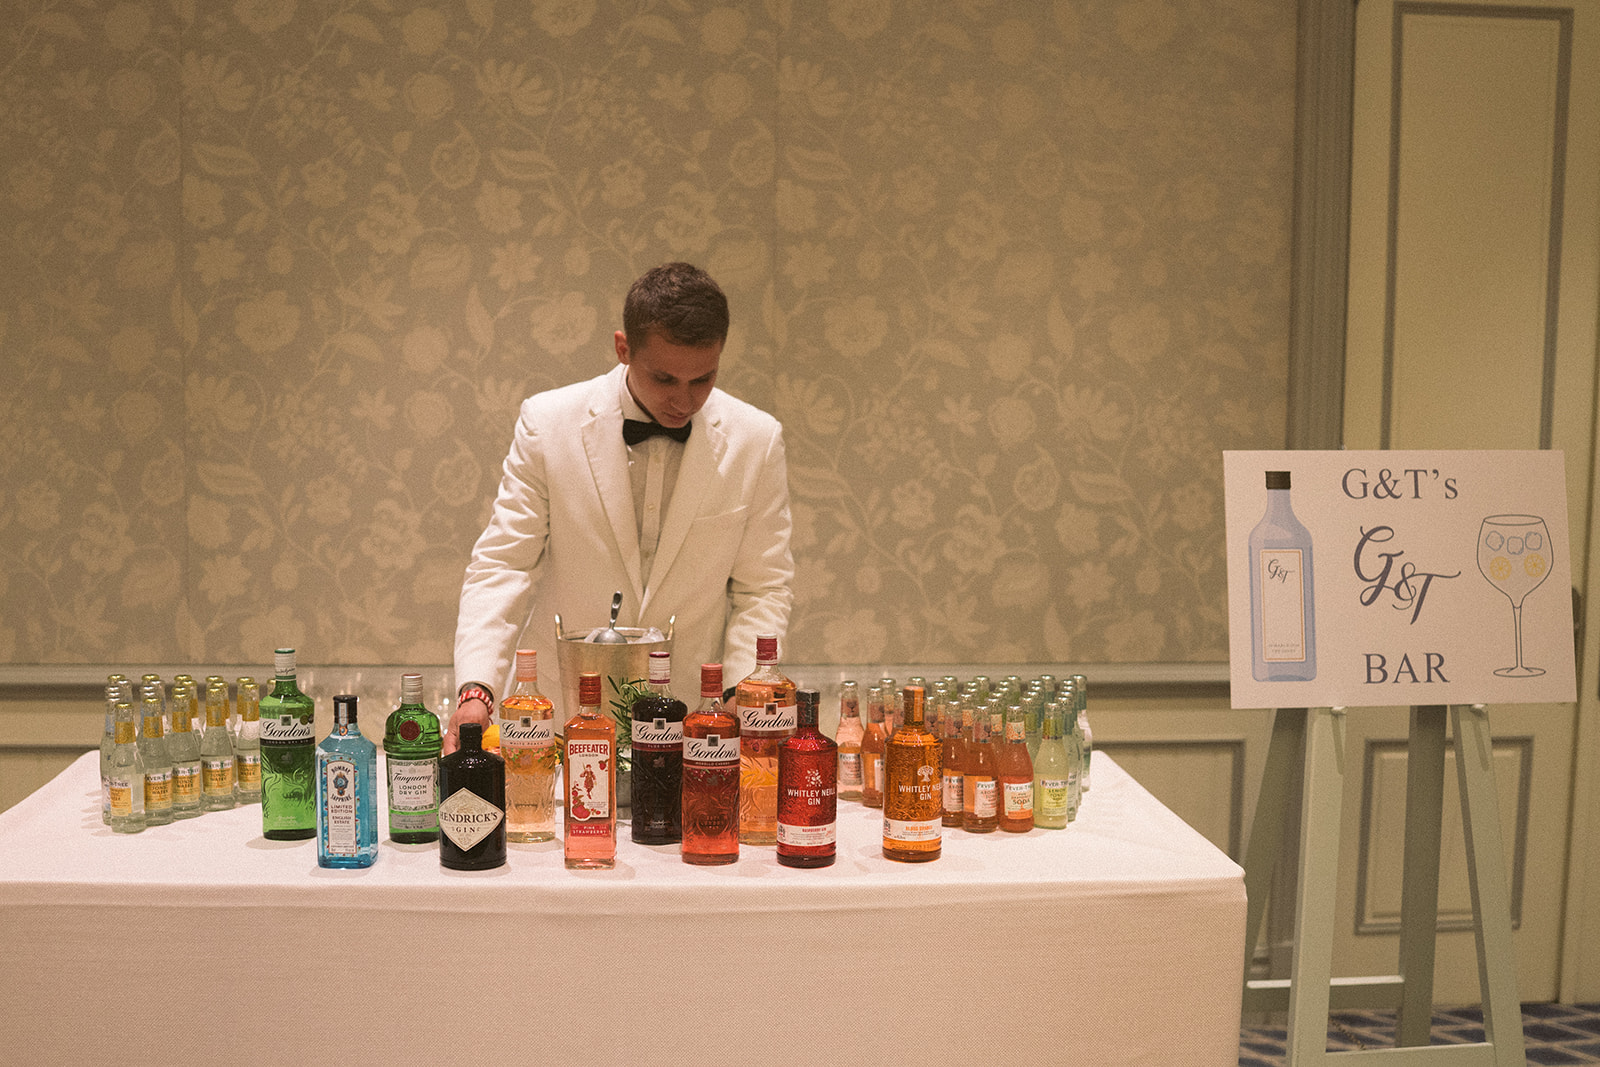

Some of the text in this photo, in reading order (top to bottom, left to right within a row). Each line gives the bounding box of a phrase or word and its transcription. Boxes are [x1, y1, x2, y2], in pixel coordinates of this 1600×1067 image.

[1267, 558, 1296, 584] G&T
[1353, 525, 1462, 626] G&T
[1362, 652, 1451, 685] BAR
[742, 709, 795, 729] Gordon's
[262, 721, 311, 738] Gordon's
[502, 722, 550, 739] Gordon's
[635, 723, 683, 742] Gordon's
[569, 743, 609, 756] BEEFEATER
[687, 741, 737, 759] Gordon's
[331, 766, 351, 774] BOMBAY
[393, 772, 432, 784] Tanqueray
[787, 789, 820, 798] WHITLEY
[899, 784, 931, 793] WHITLEY
[330, 794, 353, 802] SAPPHIRE
[807, 797, 821, 806] GIN
[919, 793, 932, 801] GIN
[440, 811, 498, 823] HENDRICK'S
